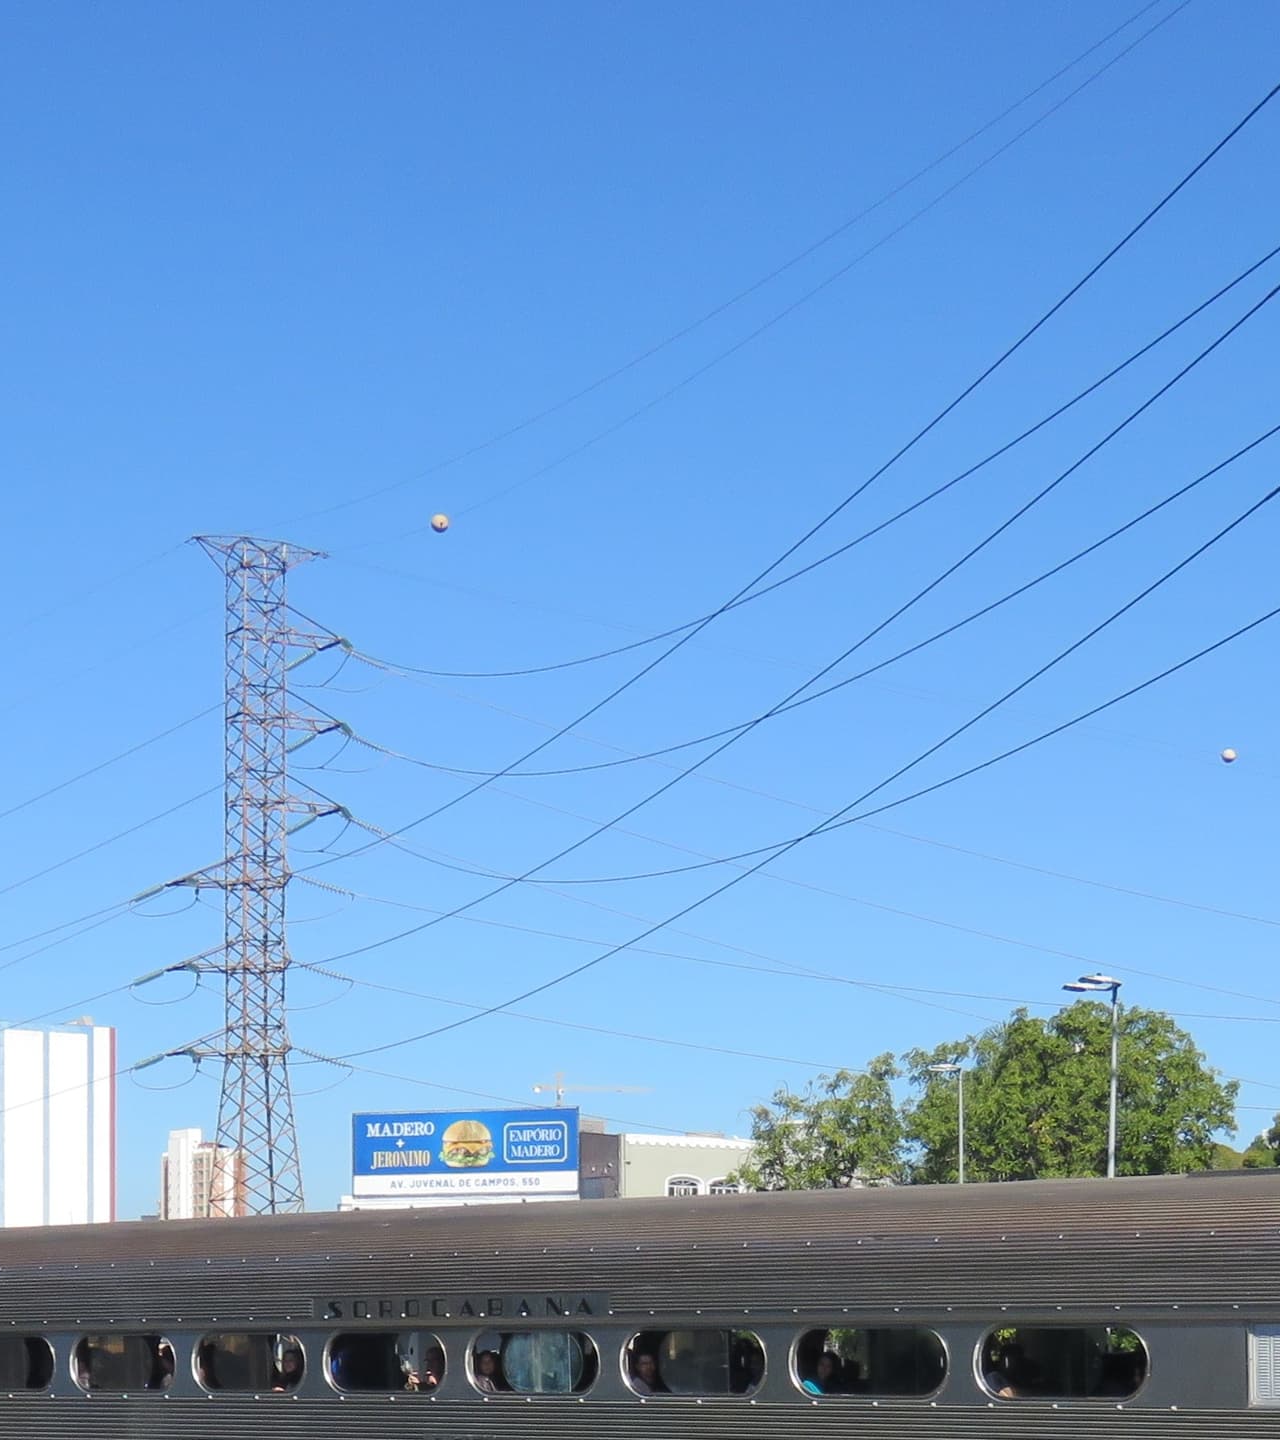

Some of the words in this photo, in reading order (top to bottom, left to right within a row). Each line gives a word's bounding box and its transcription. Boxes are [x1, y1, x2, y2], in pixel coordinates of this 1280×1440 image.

[366, 1121, 435, 1138] MADERO
[509, 1128, 562, 1142] EMPÓRIO
[511, 1144, 560, 1158] MADERO
[390, 1180, 407, 1189] AV.
[409, 1179, 455, 1189] JUVENAL
[458, 1178, 471, 1188] DE
[522, 1177, 541, 1187] 550
[327, 1296, 593, 1320] SOROCABANA
